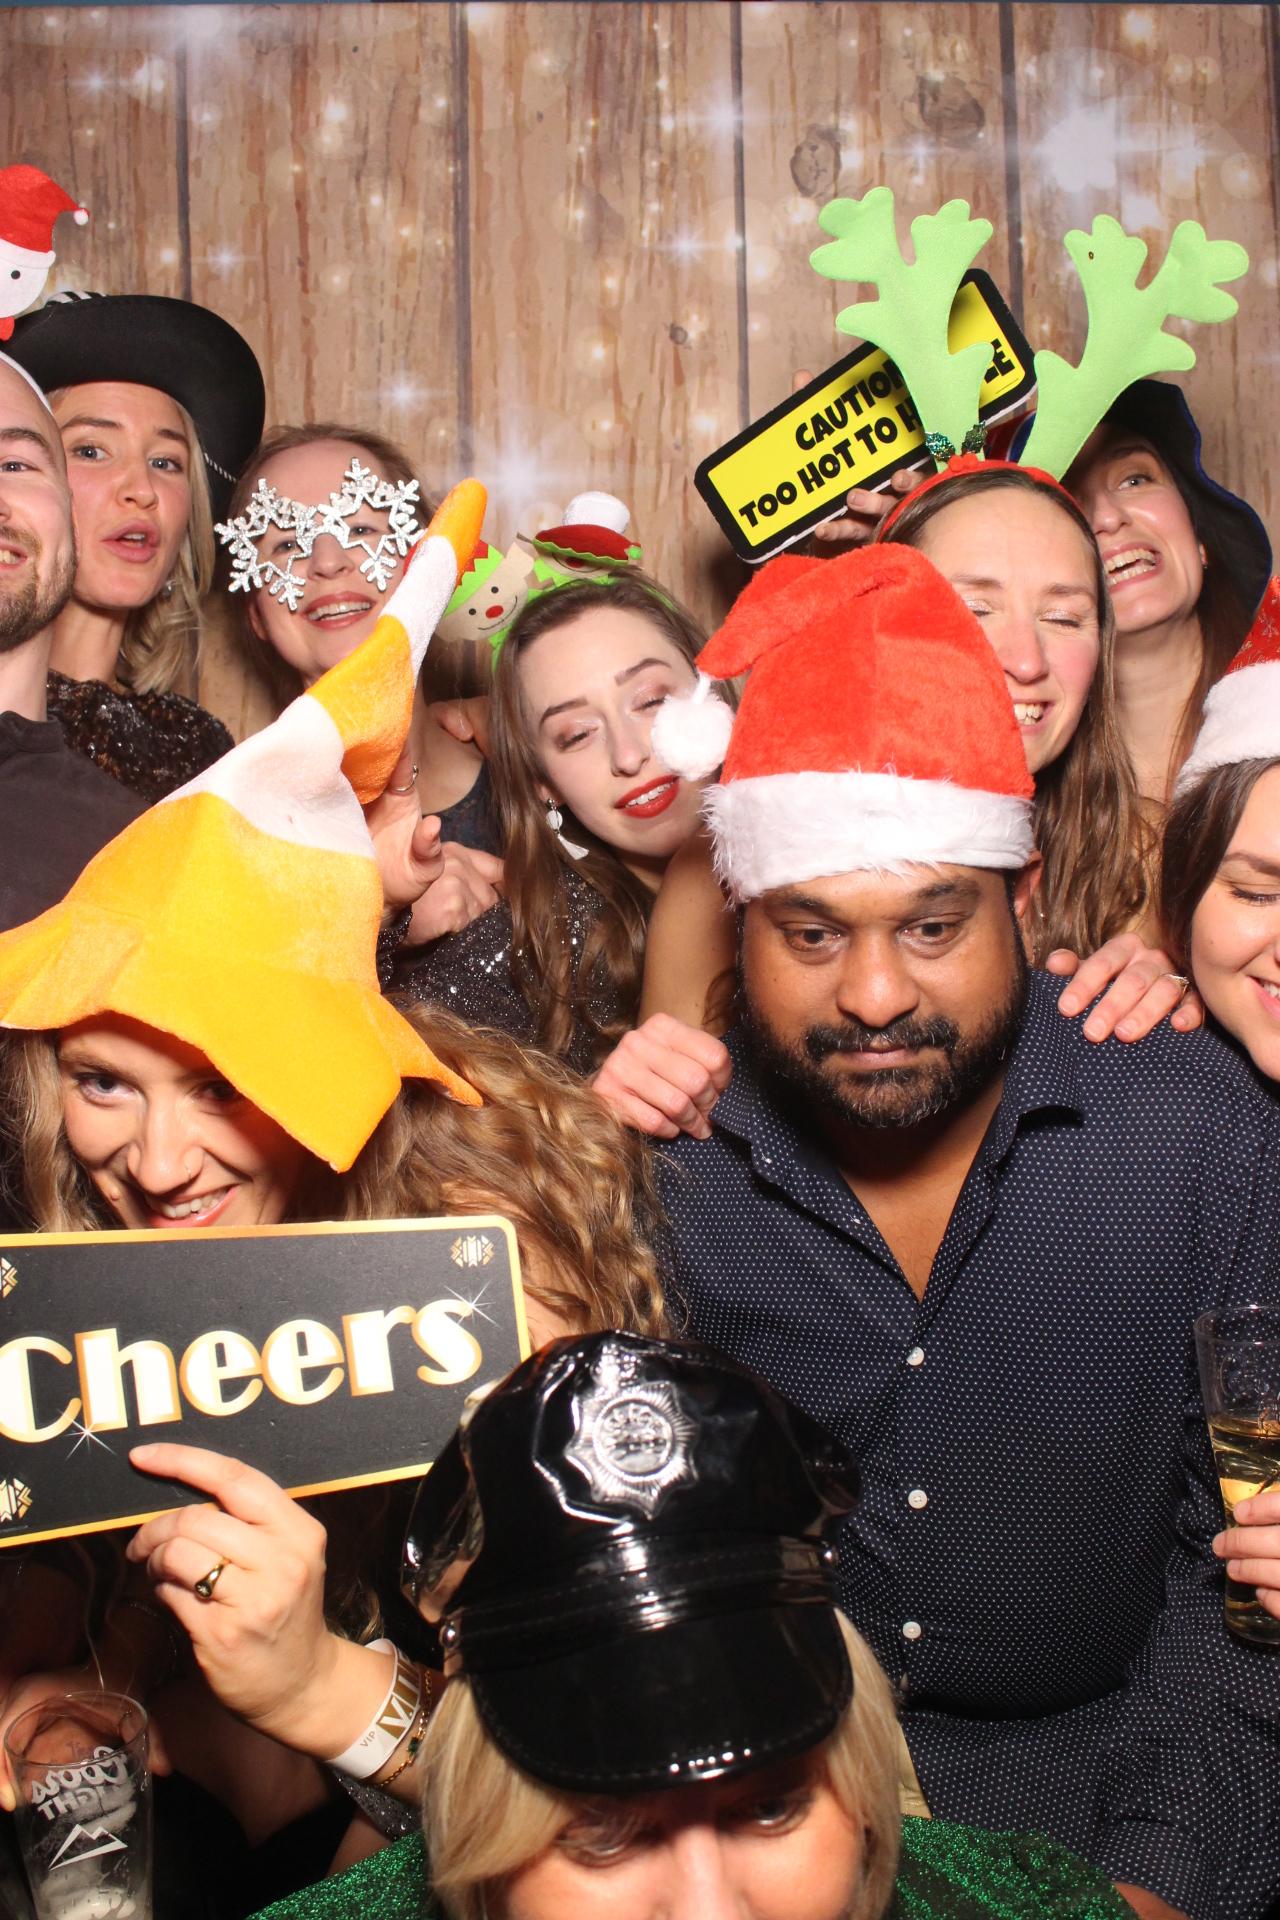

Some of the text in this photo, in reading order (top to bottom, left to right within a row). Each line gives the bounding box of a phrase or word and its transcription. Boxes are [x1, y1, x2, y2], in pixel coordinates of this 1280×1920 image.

[738, 416, 898, 528] TOO HOT TO
[0, 1298, 483, 1443] Cheers
[359, 1730, 377, 1748] VIP
